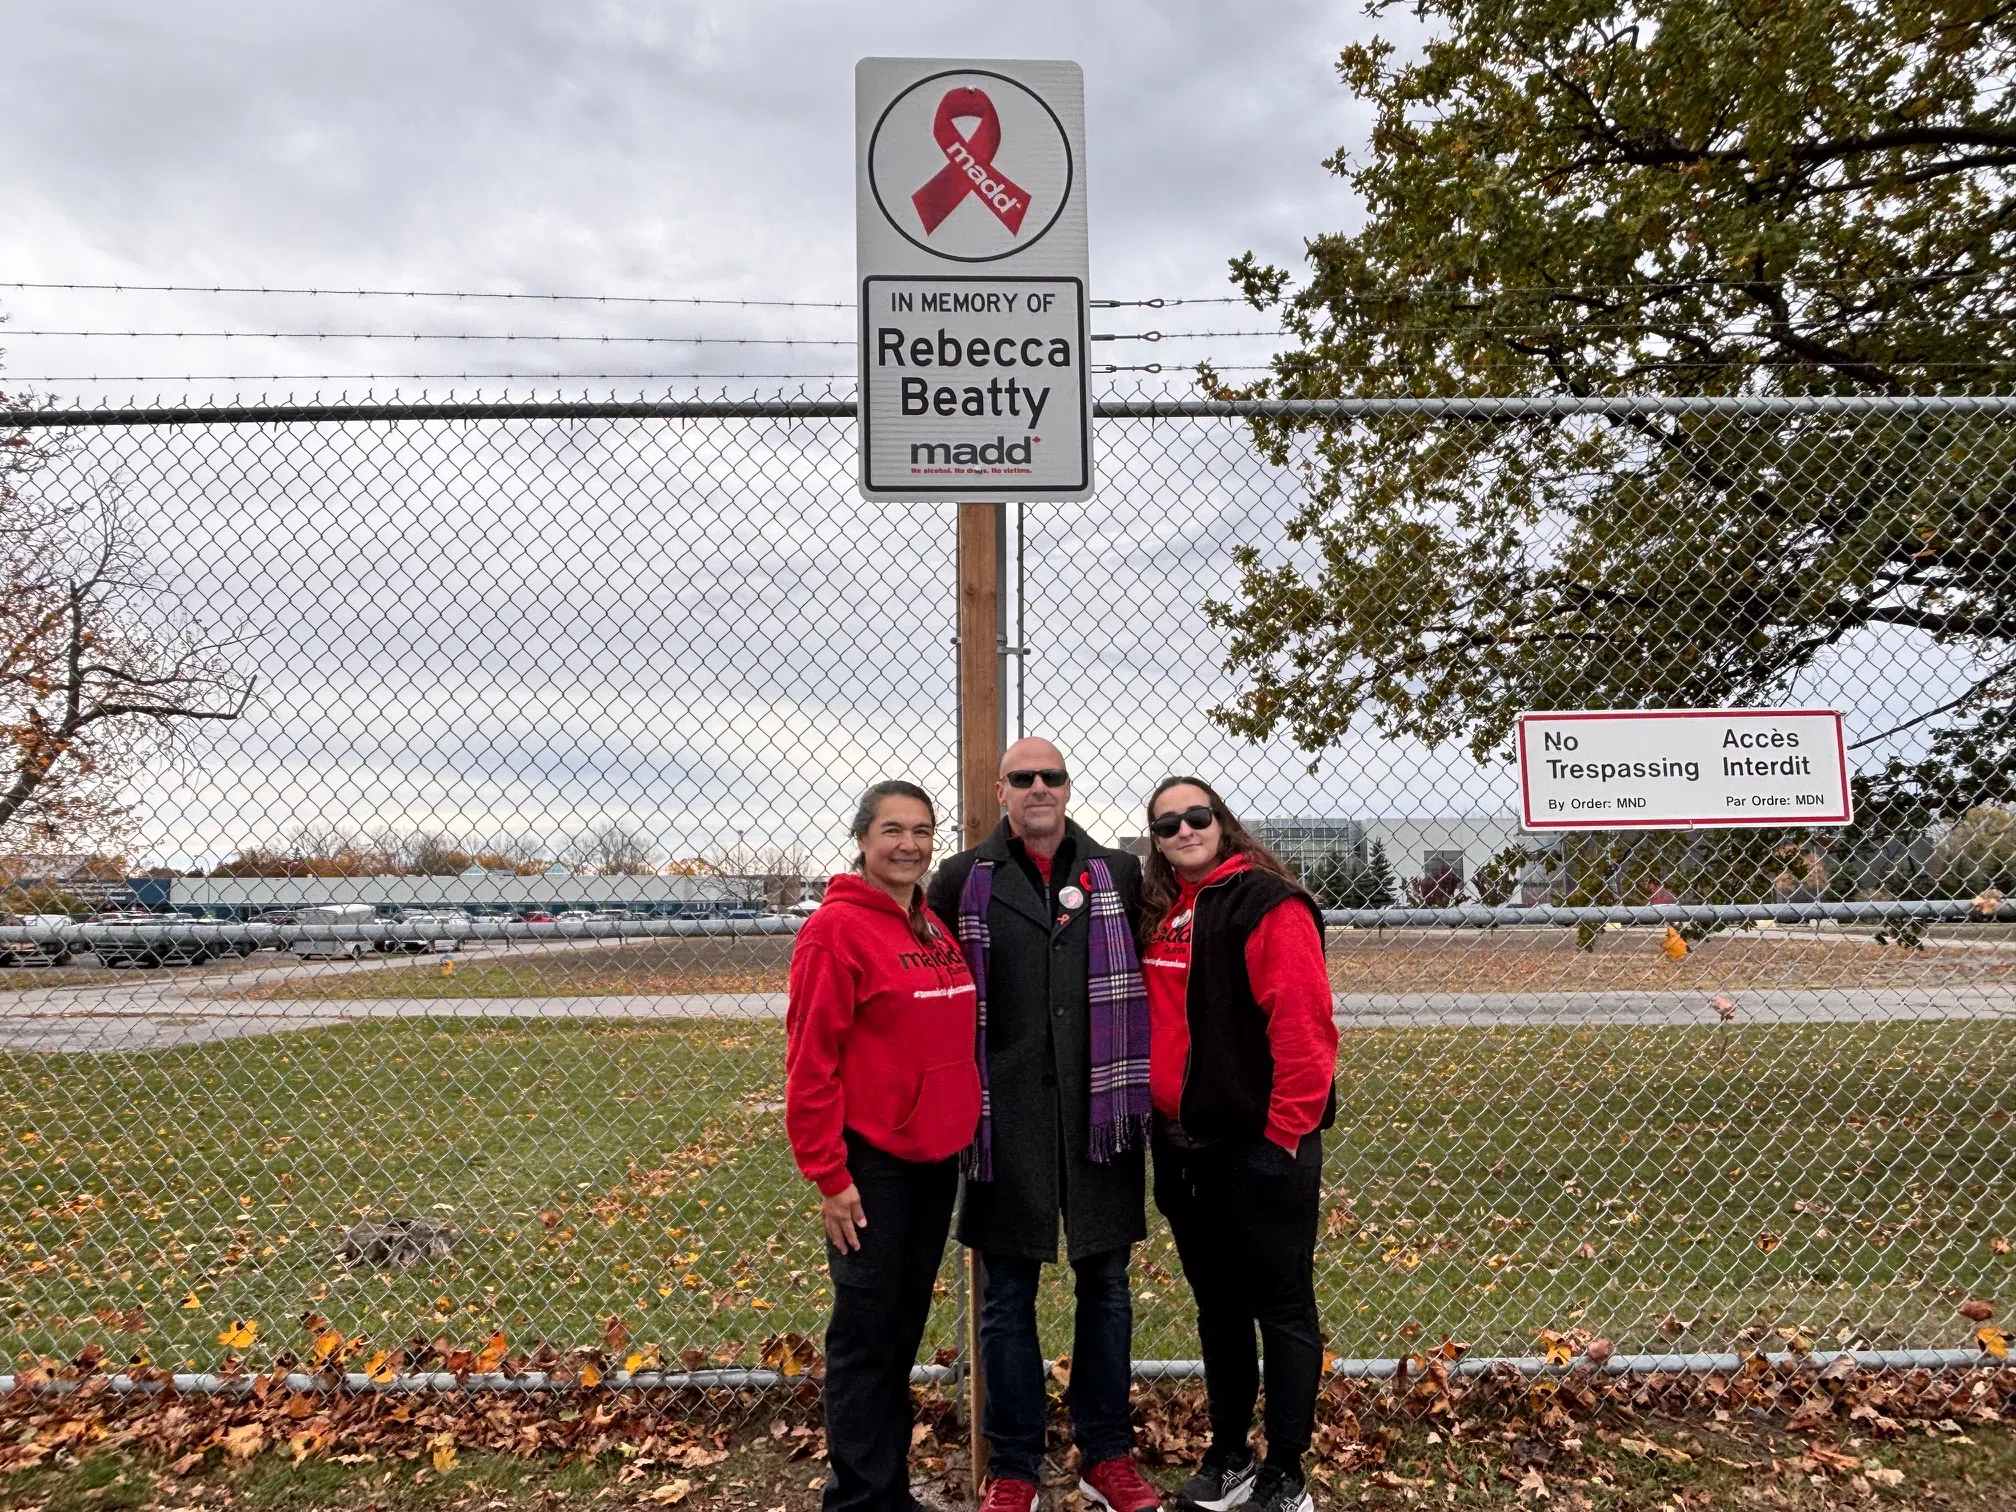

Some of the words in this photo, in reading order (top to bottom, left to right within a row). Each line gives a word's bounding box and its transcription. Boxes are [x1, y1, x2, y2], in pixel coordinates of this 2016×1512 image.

[946, 141, 1018, 214] madd
[891, 292, 913, 312] IN
[921, 292, 1019, 313] MEMORY
[1026, 293, 1056, 313] OF
[877, 327, 1071, 368] Rebecca
[900, 376, 1051, 430] Beatty
[910, 436, 1032, 465] madd
[1544, 731, 1579, 752] No
[1722, 728, 1800, 749] Accès
[1546, 757, 1700, 782] Trespassing
[1723, 755, 1811, 776] Interdit
[1548, 799, 1565, 811] By
[1571, 798, 1612, 810] Order:
[1617, 797, 1647, 809] MND
[1726, 796, 1747, 807] Par
[1751, 795, 1791, 806] Ordre:
[1795, 794, 1825, 805] MDN
